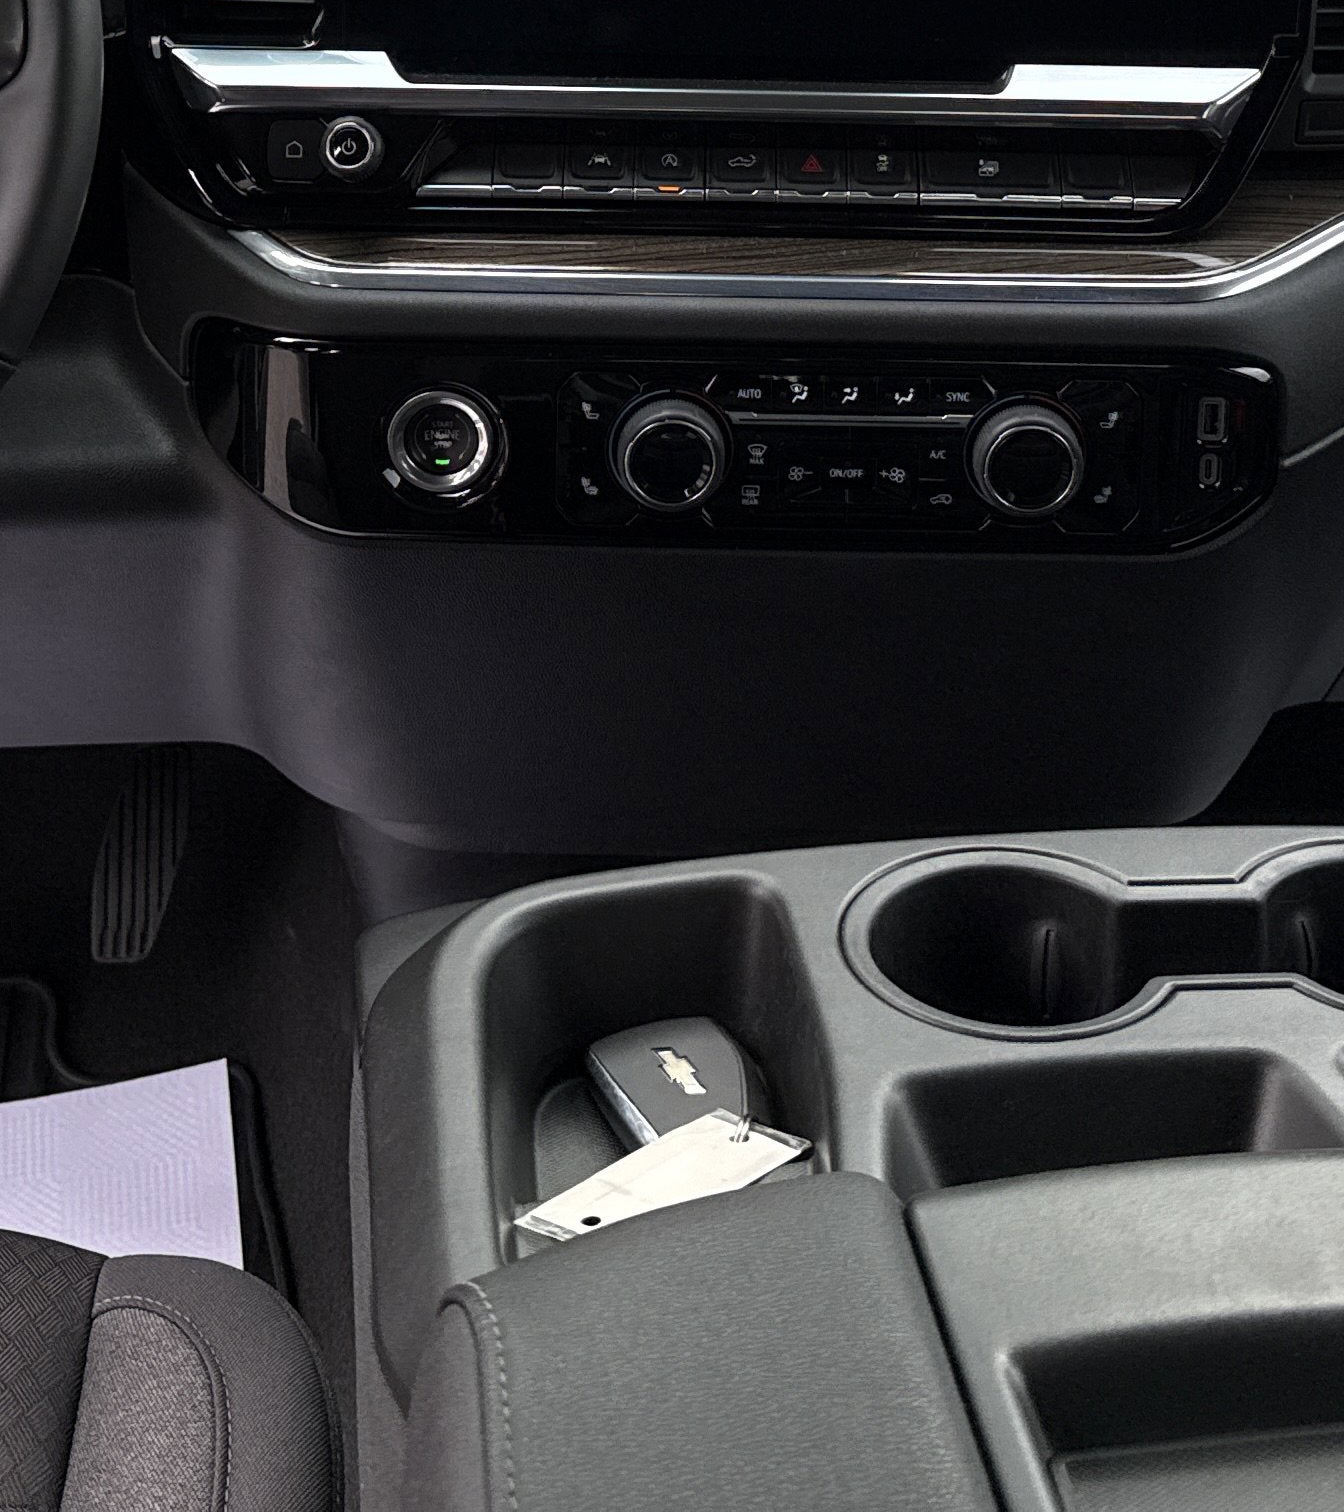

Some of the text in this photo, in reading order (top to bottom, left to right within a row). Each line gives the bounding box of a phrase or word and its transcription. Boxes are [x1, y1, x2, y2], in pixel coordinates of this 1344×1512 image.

[737, 388, 762, 399] AUTO
[945, 391, 971, 403] SYNC
[431, 420, 454, 429] START
[424, 429, 460, 441] ENGINE
[929, 449, 947, 460] A/C
[829, 467, 864, 478] ON/OFF
